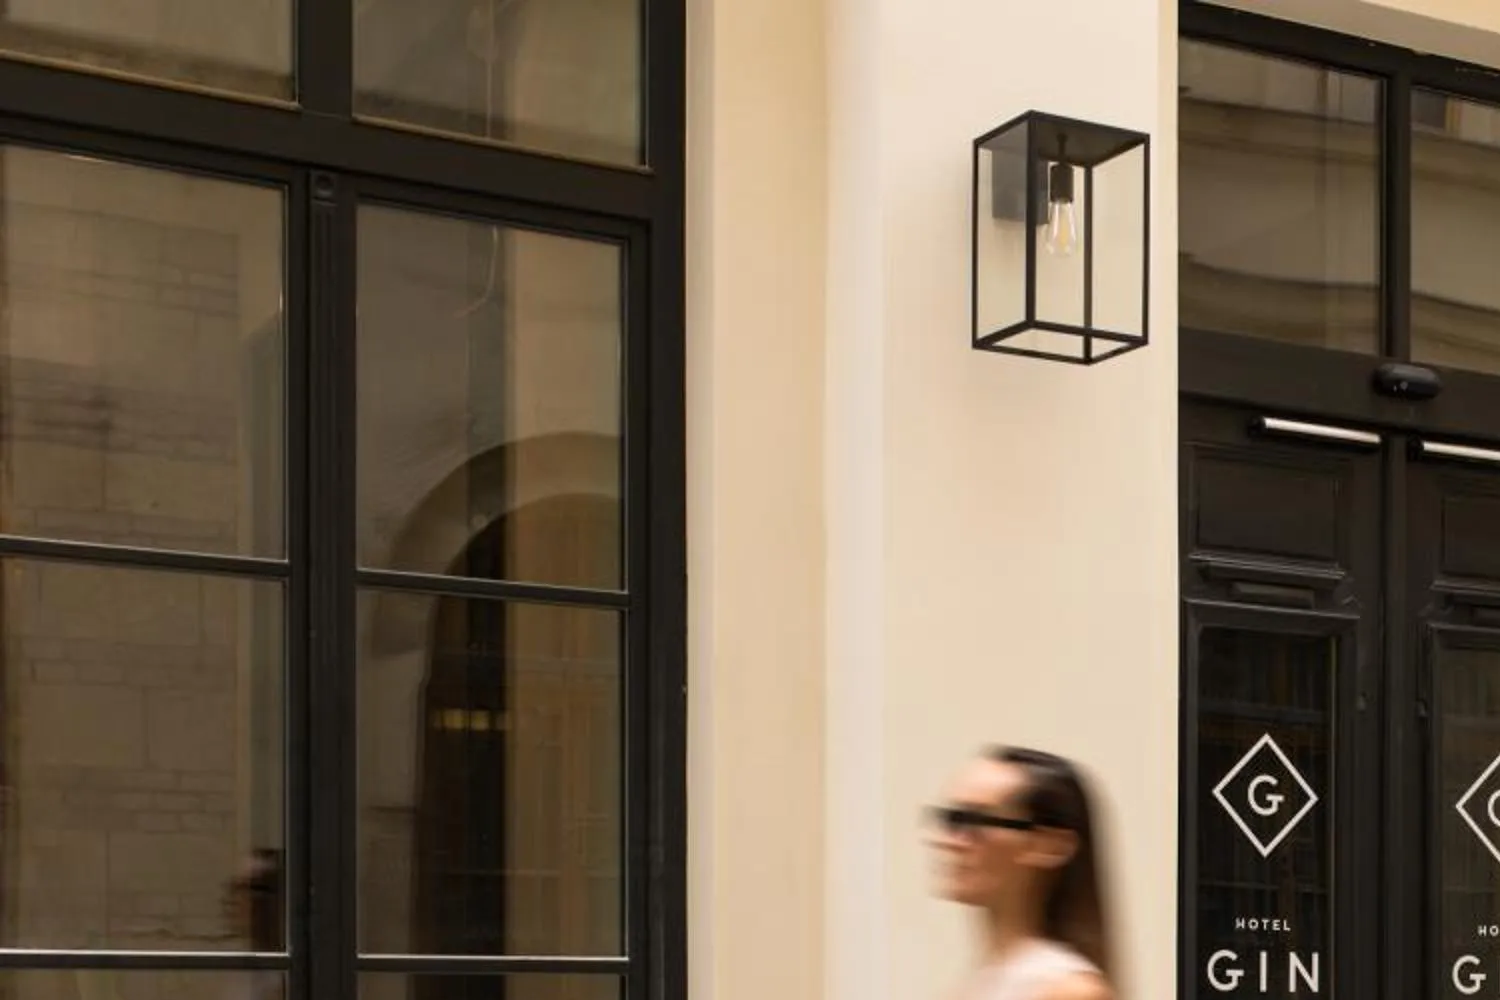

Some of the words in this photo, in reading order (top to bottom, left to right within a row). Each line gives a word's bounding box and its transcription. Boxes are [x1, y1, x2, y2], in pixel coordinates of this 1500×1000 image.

[1247, 774, 1285, 817] G
[1235, 917, 1292, 932] HOTEL
[1206, 949, 1320, 993] GIN
